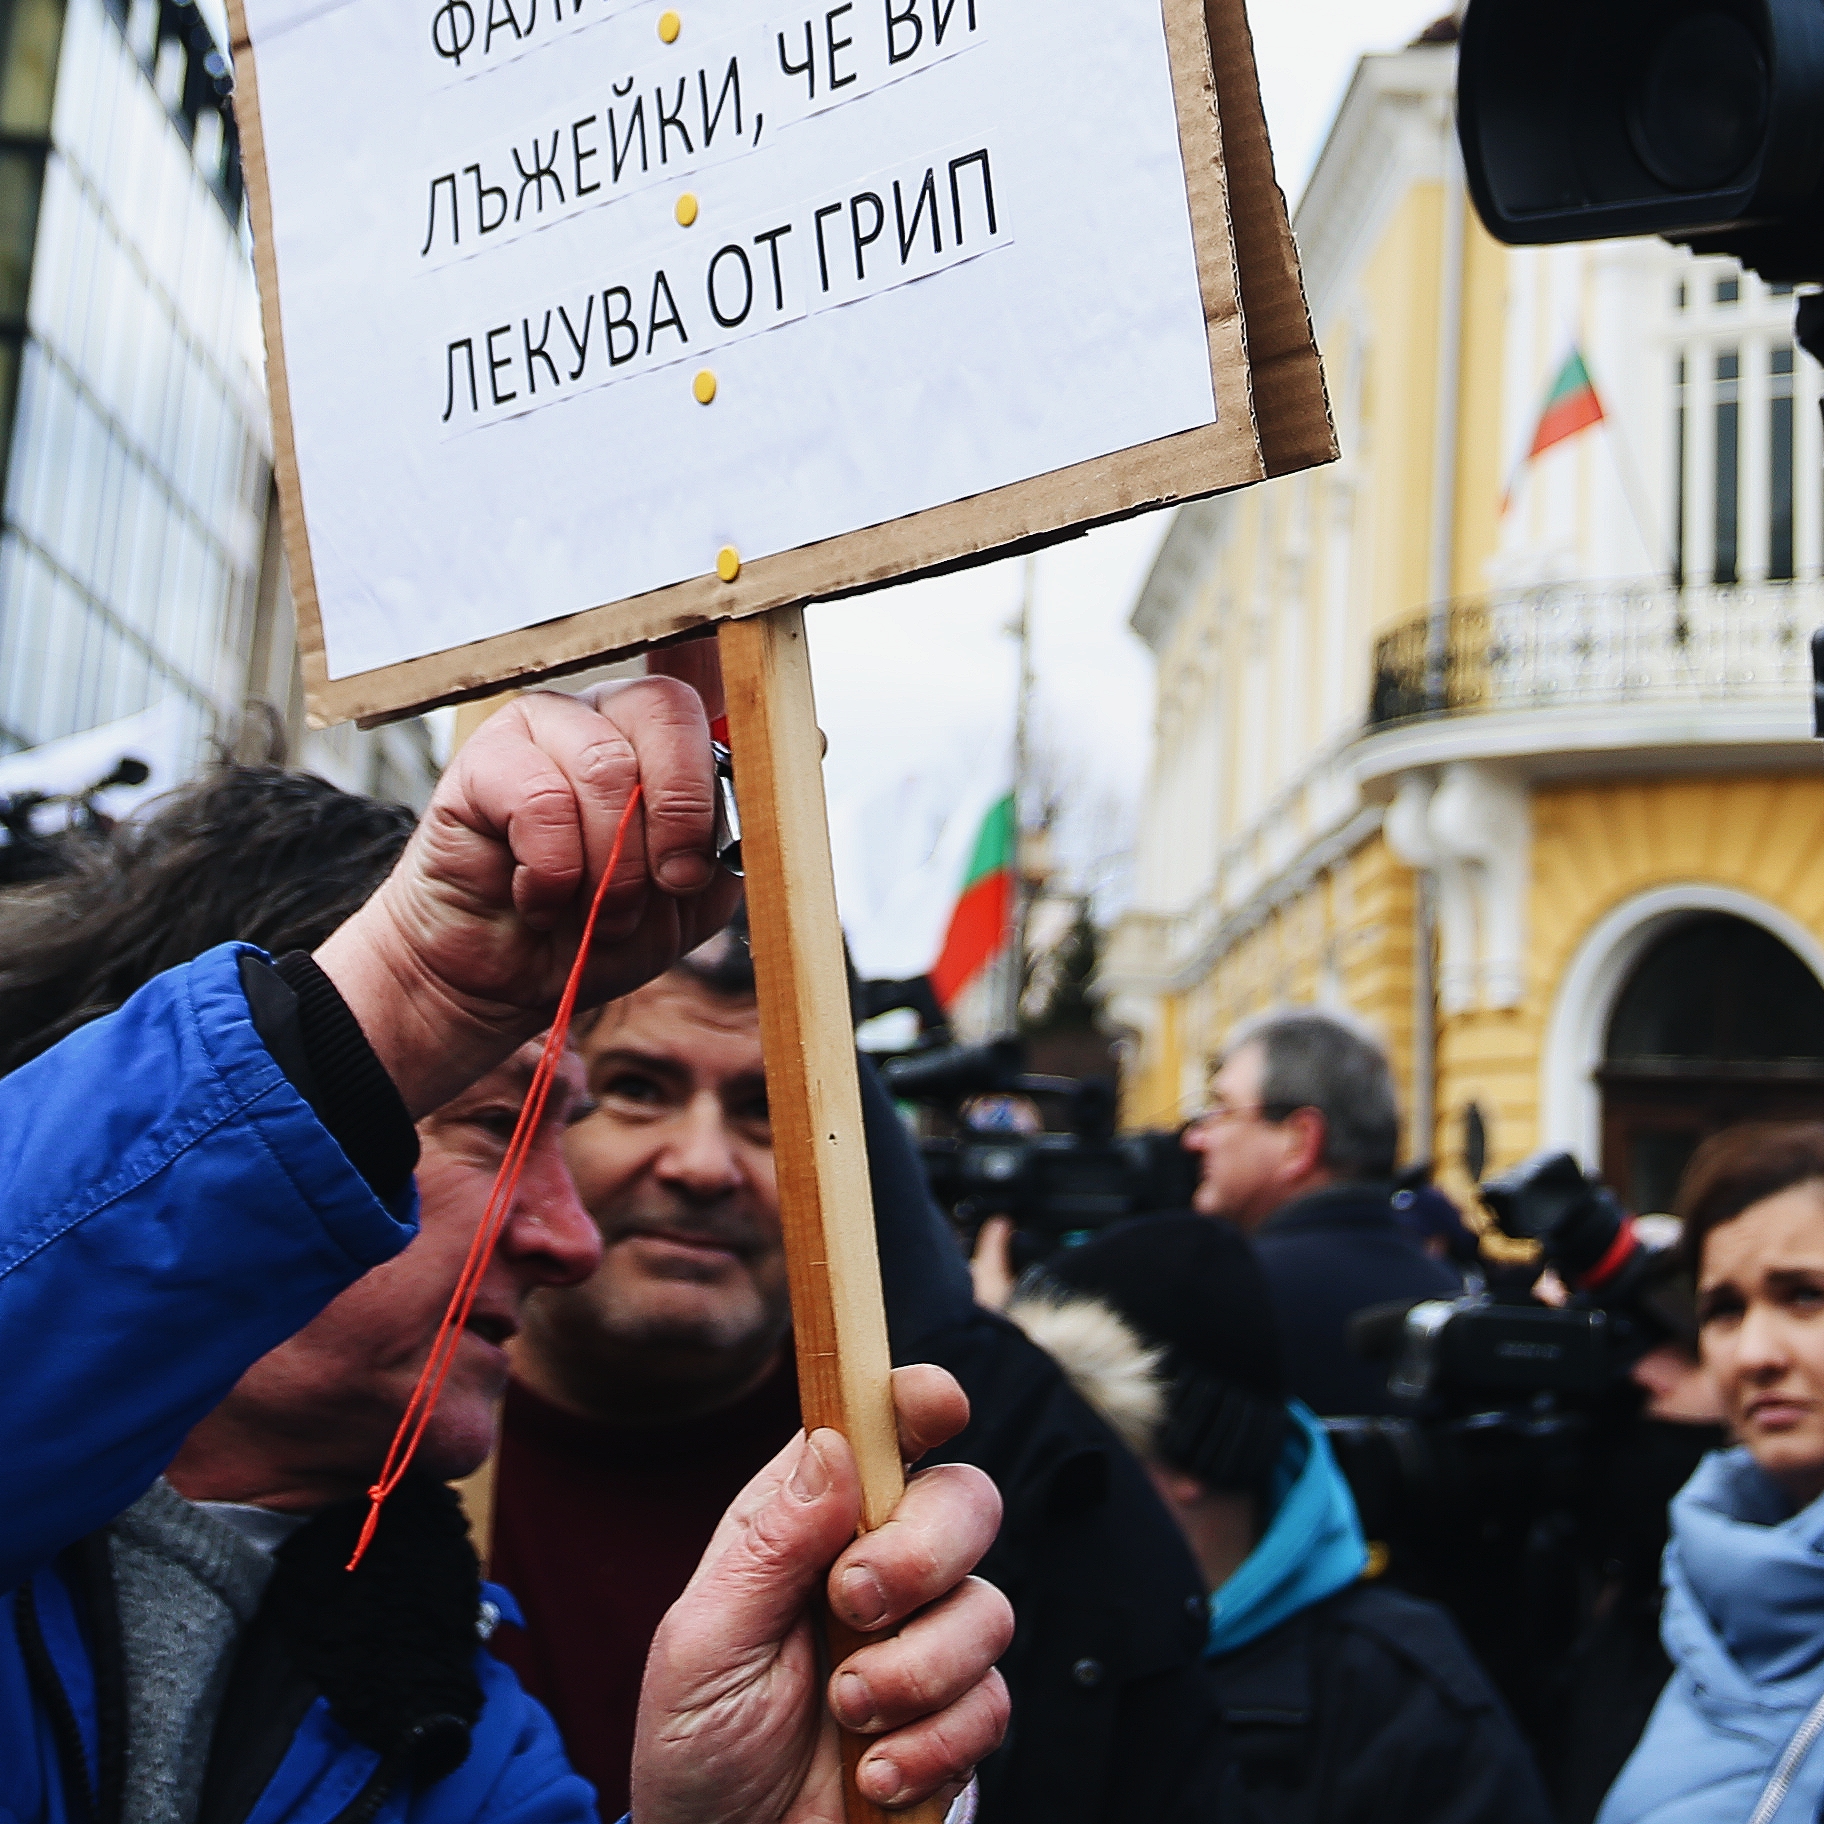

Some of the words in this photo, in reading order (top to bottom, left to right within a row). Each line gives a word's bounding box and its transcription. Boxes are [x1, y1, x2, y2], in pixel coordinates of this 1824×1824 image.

[421, 56, 765, 257] ЛЪЖЕЙКИ,
[776, 1, 858, 100] ЧЕ
[442, 269, 689, 423] ЛЕКУВА
[707, 223, 793, 329] ОТ
[814, 147, 998, 293] ГРИП
